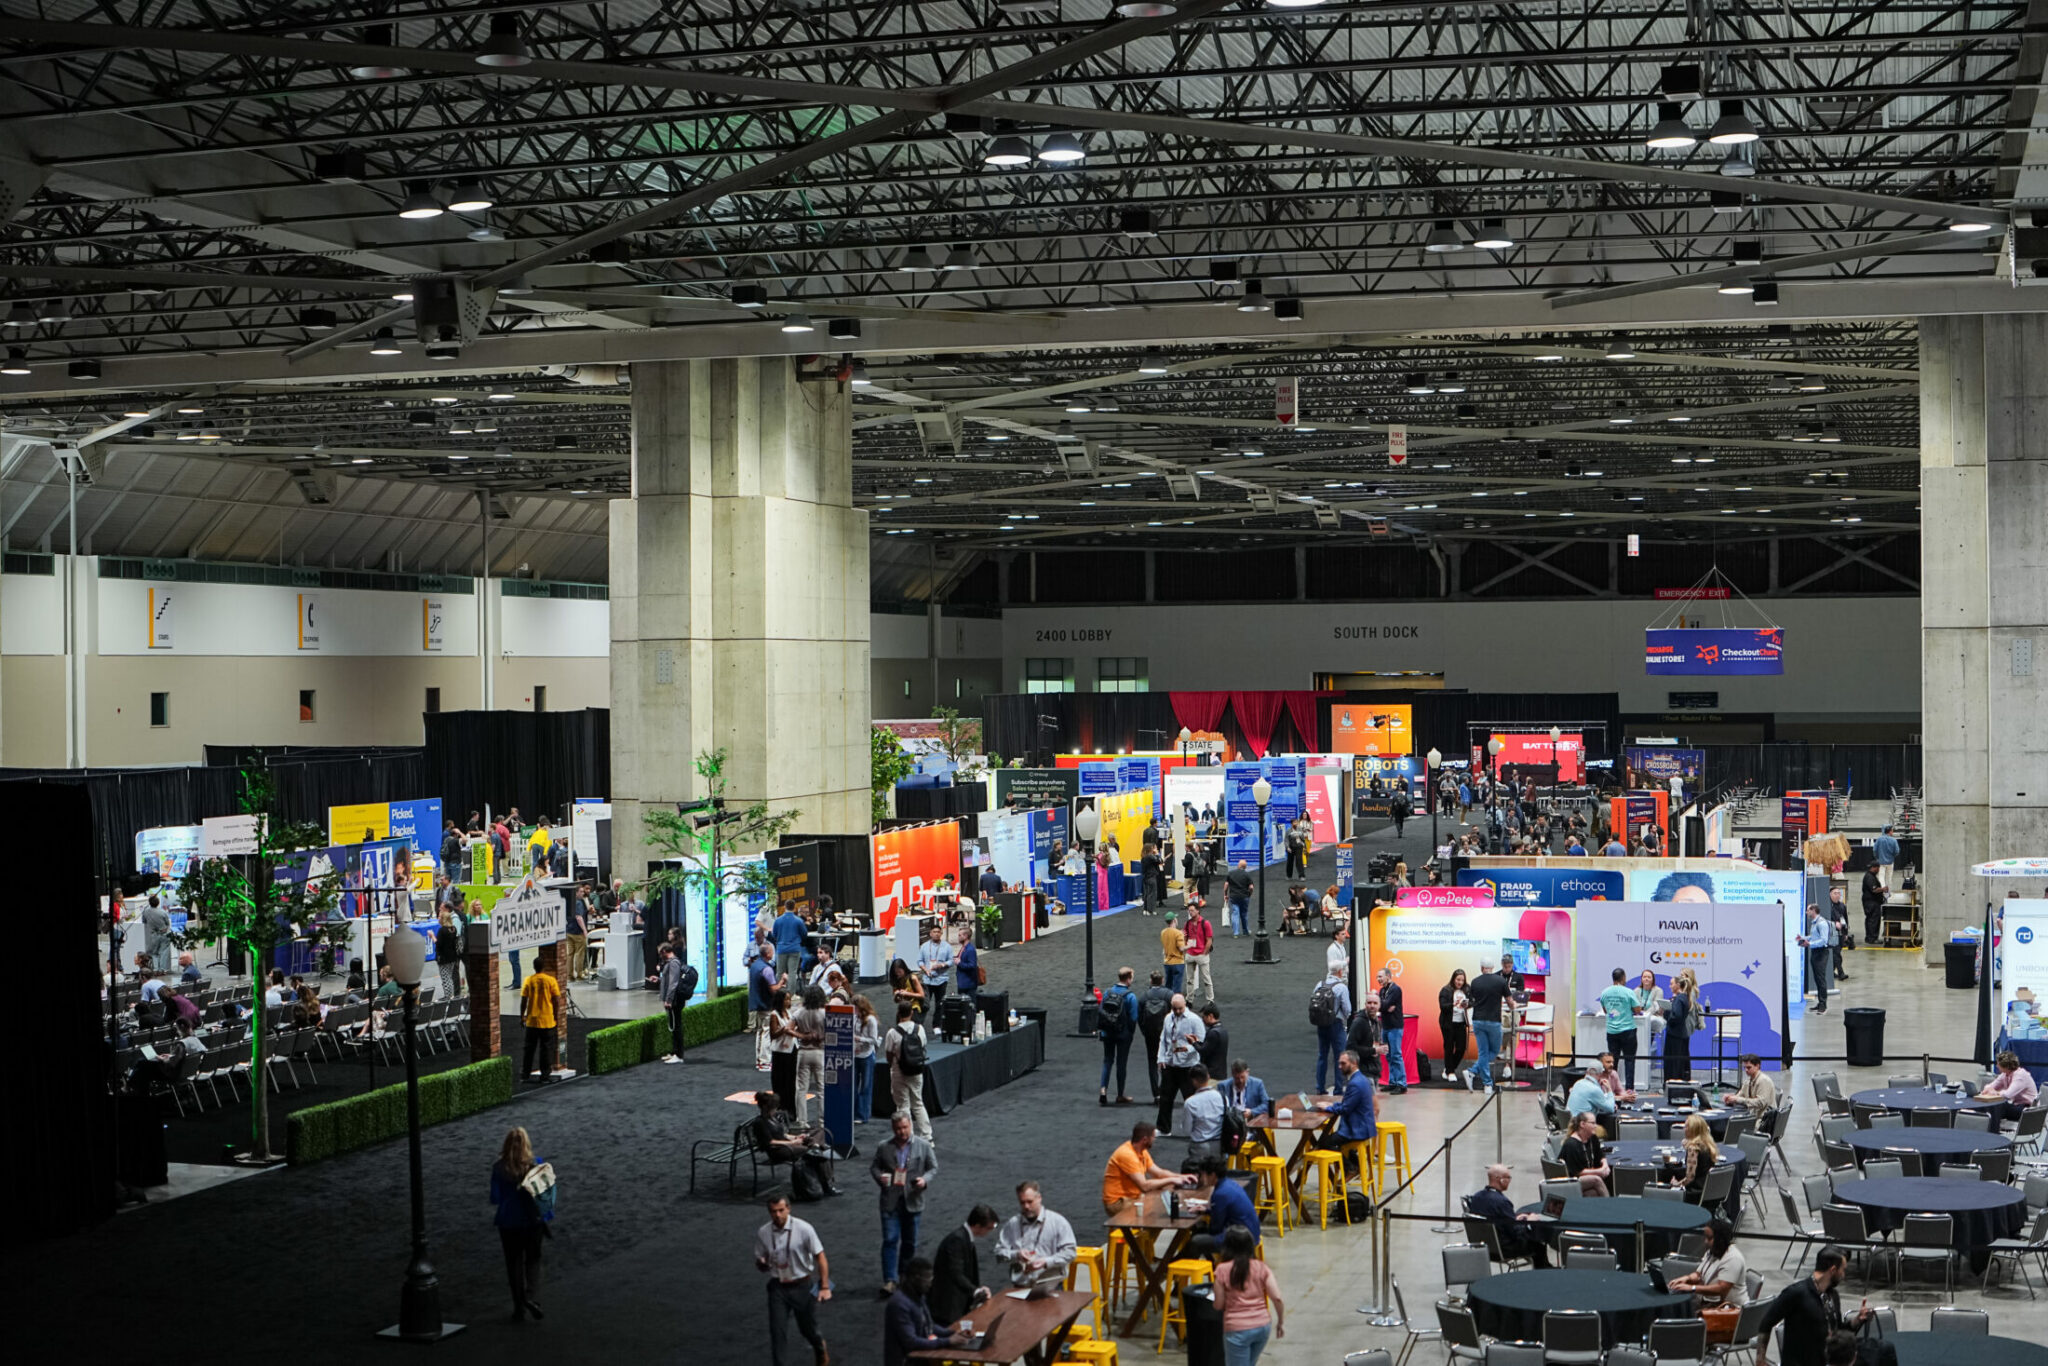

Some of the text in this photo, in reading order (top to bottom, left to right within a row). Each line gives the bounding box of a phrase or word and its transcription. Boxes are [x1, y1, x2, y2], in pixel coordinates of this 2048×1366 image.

[1278, 386, 1291, 394] FIRE
[1277, 395, 1294, 404] PLUG
[1391, 431, 1403, 439] FIRE
[1659, 590, 1726, 598] EMERGENCY EXIT
[1036, 629, 1113, 641] 2400 LOBBY
[1334, 626, 1420, 640] SOUTH DOCK
[1189, 741, 1213, 749] STATE
[1355, 759, 1409, 771] ROBOTS
[392, 807, 414, 820] Picked.
[1337, 871, 1353, 879] APP
[1500, 882, 1533, 890] FRAUD
[1561, 878, 1606, 891] ethoca
[1434, 891, 1474, 905] rePete
[1500, 890, 1542, 898] DEFLECT
[496, 905, 561, 938] PARAMOUNT
[508, 930, 551, 945] AMPHITHEATER
[1616, 934, 1743, 946] The #1 business travel platform
[825, 1017, 853, 1028] WIFI
[825, 1058, 853, 1071] APP
